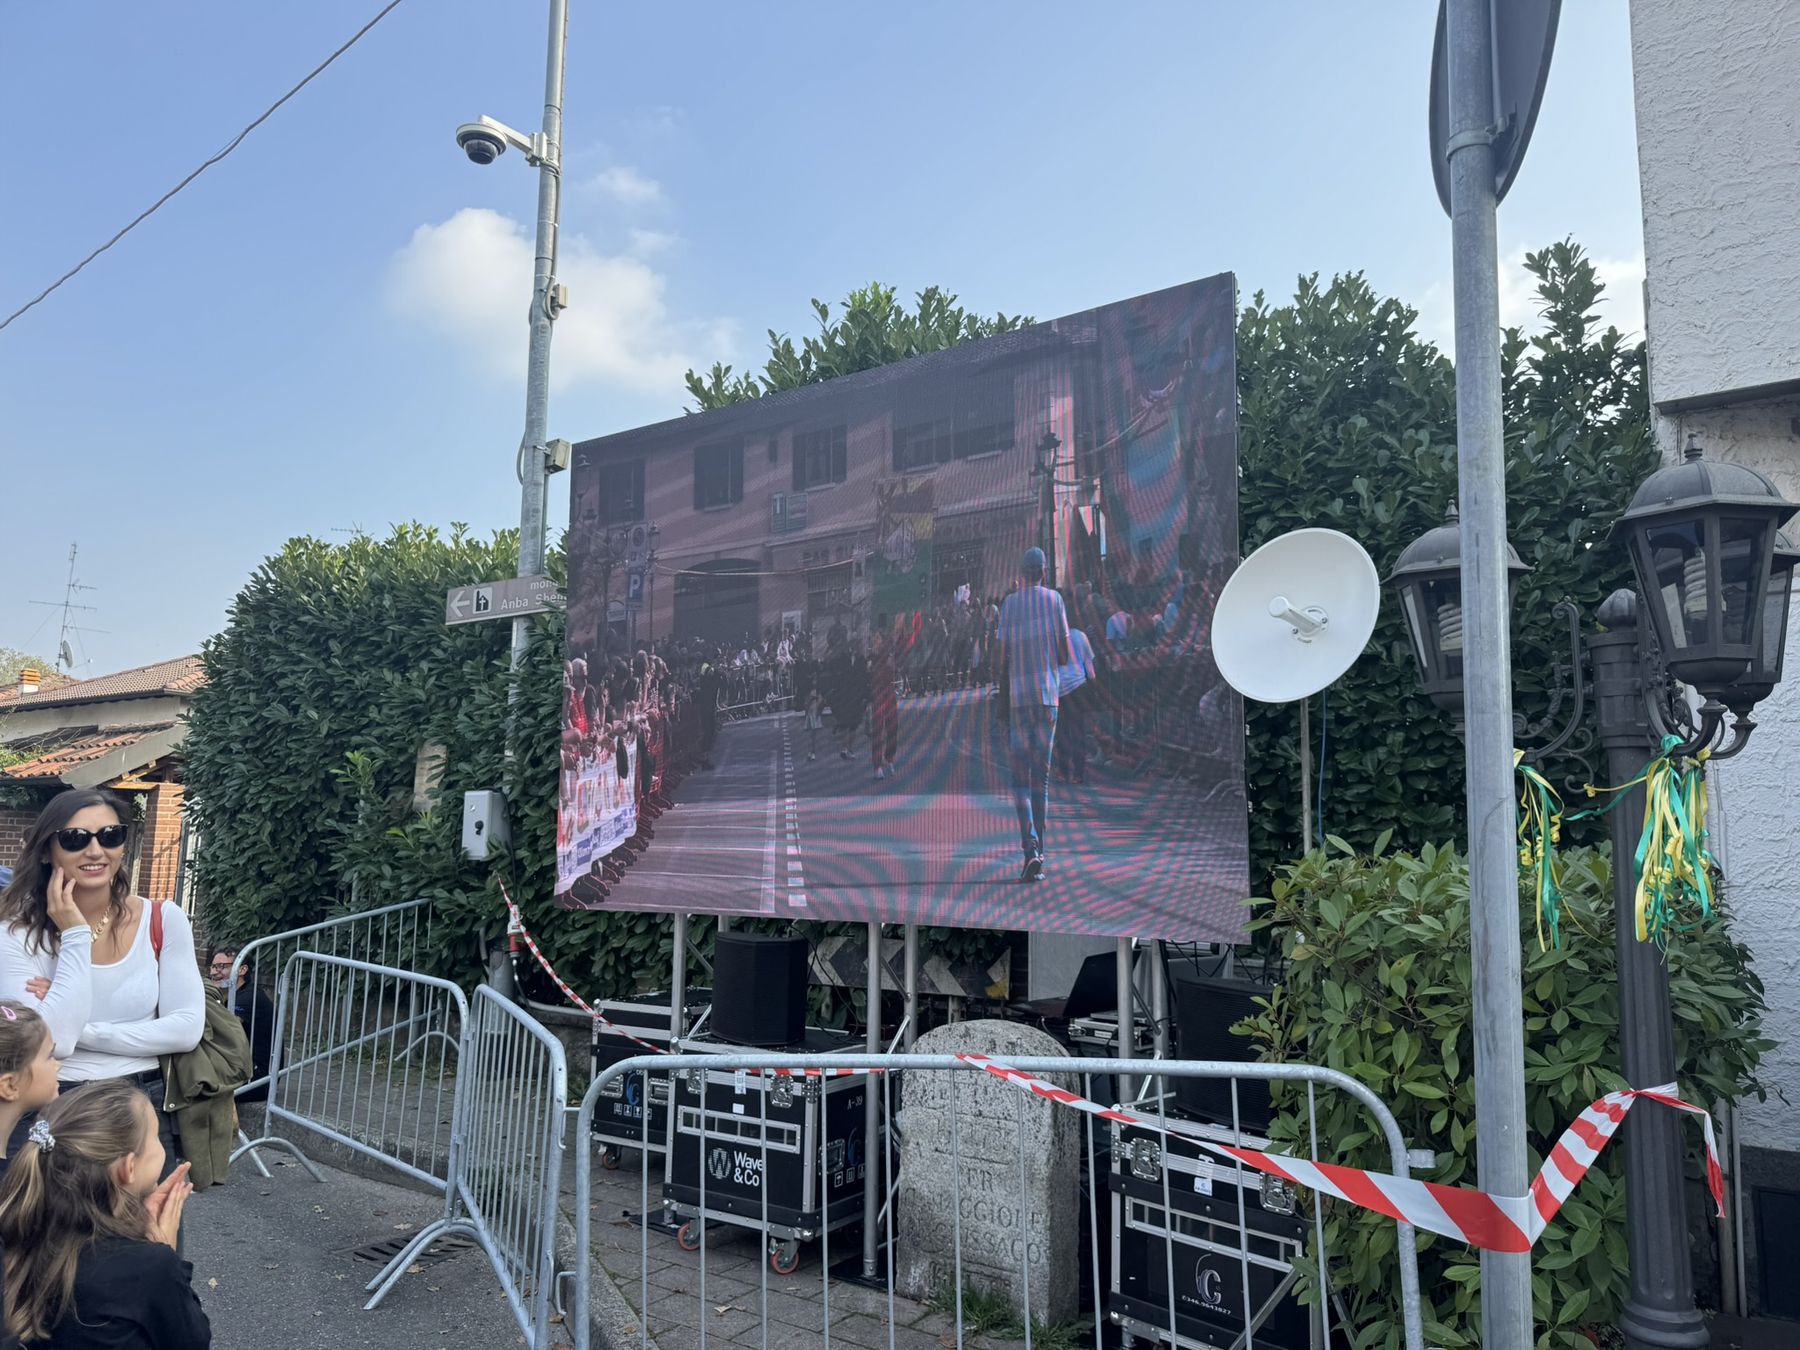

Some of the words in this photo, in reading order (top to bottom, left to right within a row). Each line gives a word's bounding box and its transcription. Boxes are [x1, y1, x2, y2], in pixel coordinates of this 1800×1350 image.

[630, 574, 641, 598] P
[501, 596, 529, 611] Anba
[733, 1150, 763, 1171] Wave
[733, 1167, 760, 1187] &Co
